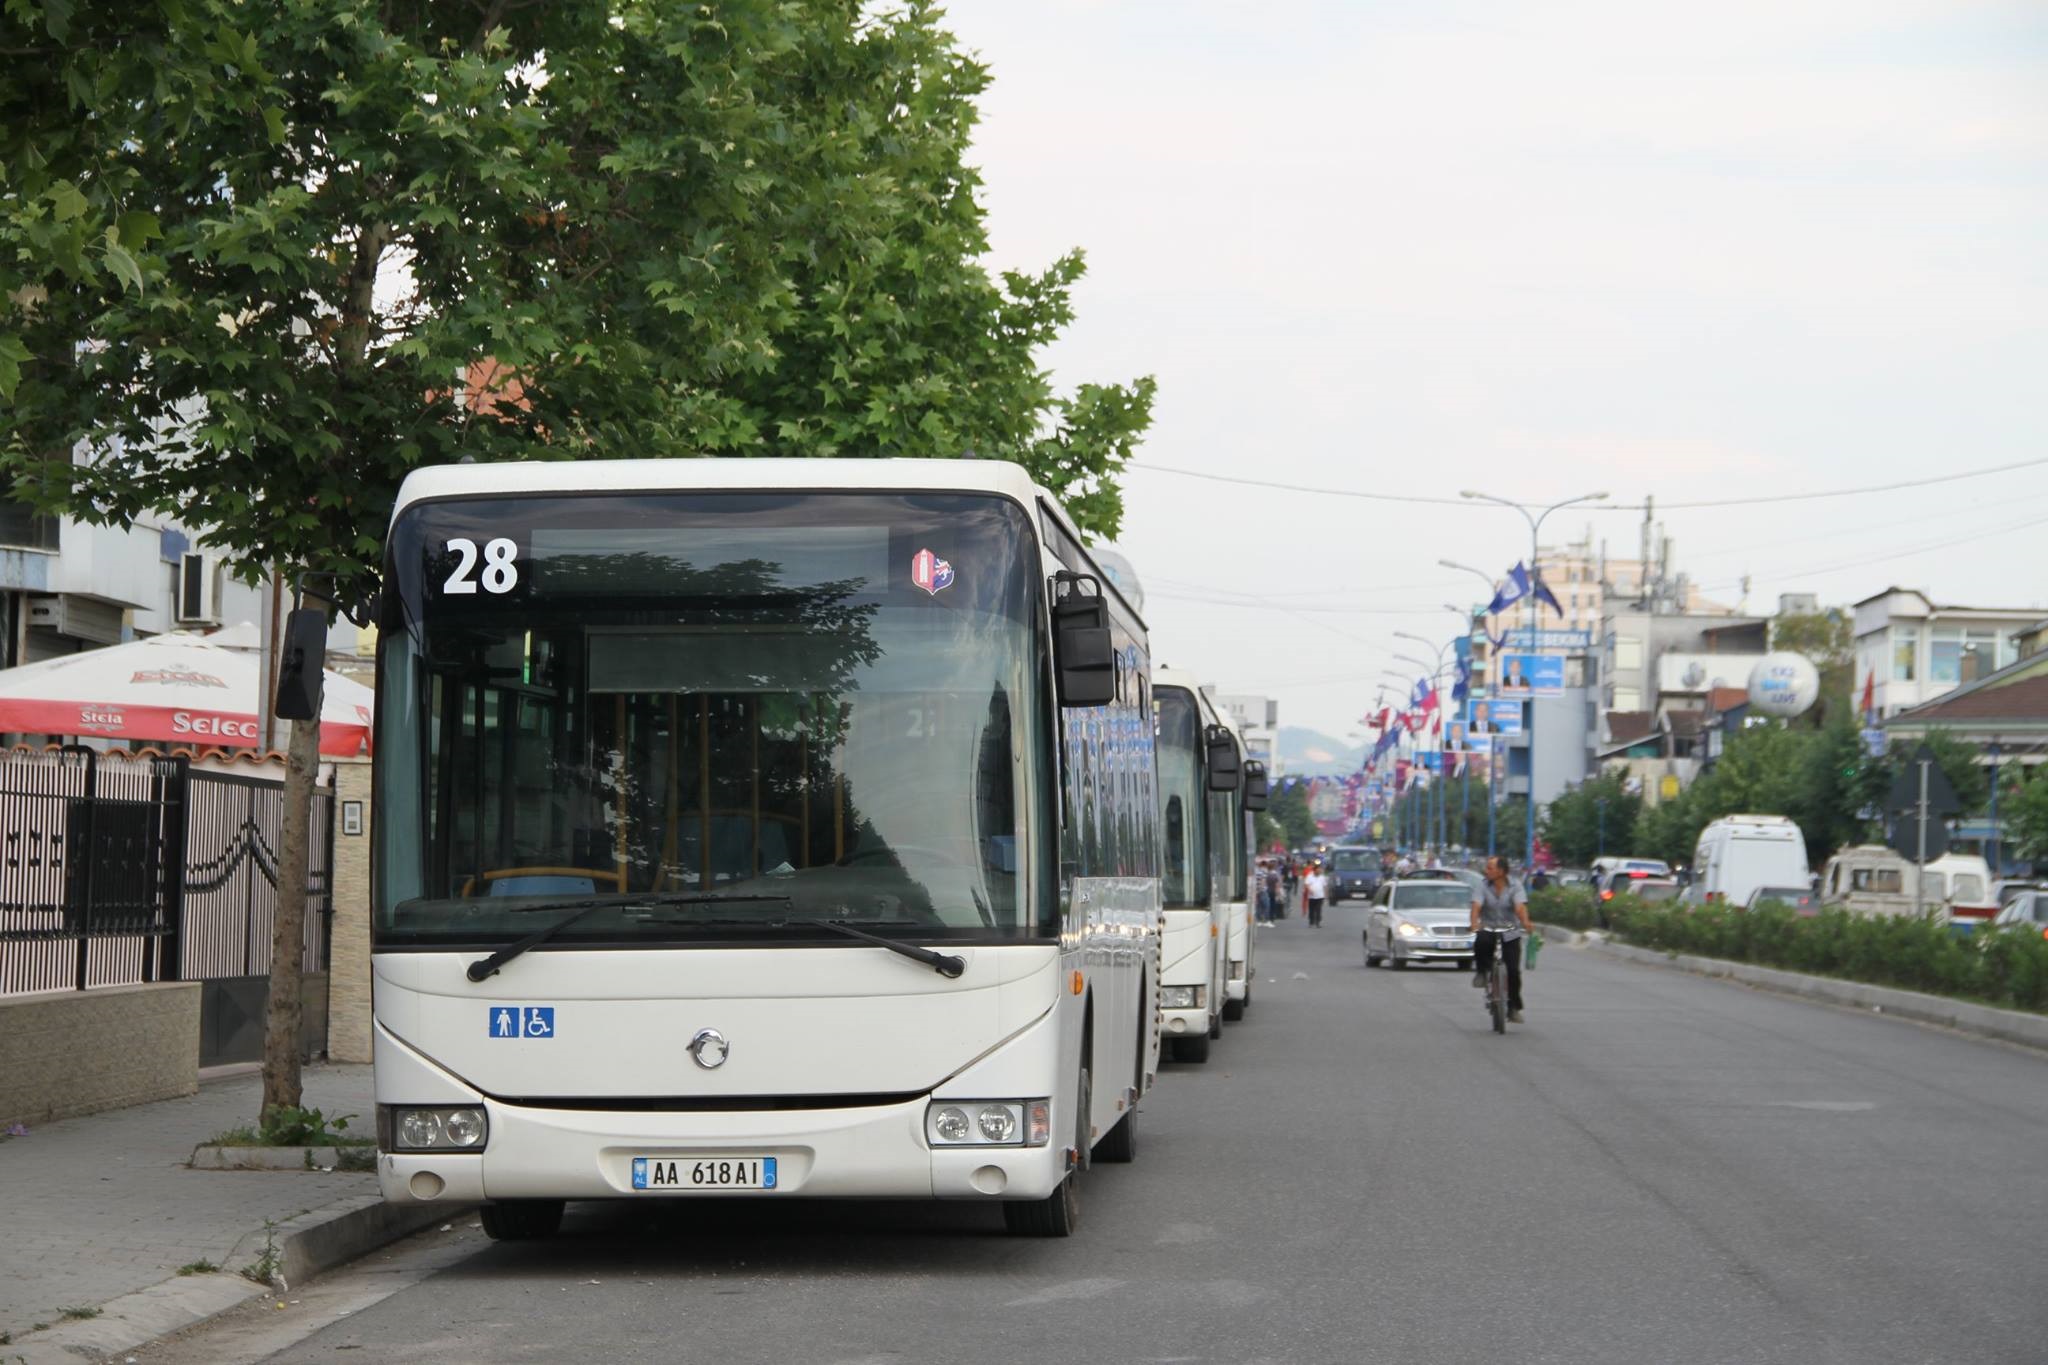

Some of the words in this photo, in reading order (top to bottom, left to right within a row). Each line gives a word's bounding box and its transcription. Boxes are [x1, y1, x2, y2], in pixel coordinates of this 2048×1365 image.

[443, 537, 518, 595] 28
[171, 712, 257, 739] Selec
[653, 1162, 679, 1184] AA
